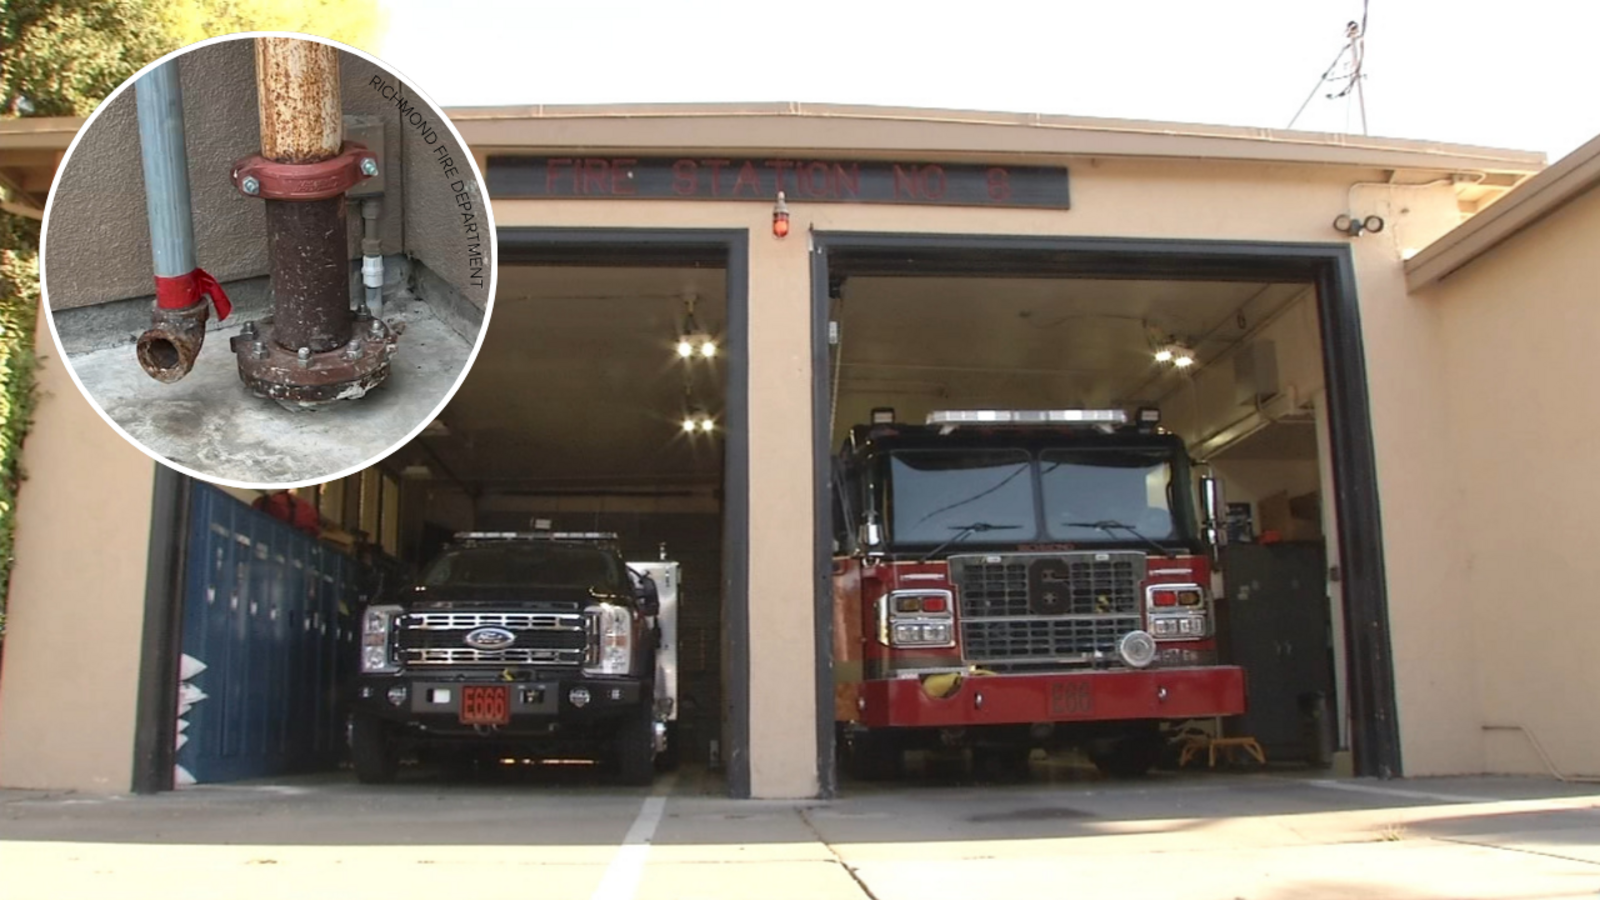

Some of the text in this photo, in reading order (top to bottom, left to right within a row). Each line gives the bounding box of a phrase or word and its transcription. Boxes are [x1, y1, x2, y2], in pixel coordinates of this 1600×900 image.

[545, 158, 637, 195] FIRE
[670, 159, 860, 198] STATION
[893, 163, 947, 199] NO
[1028, 558, 1072, 615] 6
[464, 687, 505, 719] E666
[1052, 682, 1092, 714] E66
